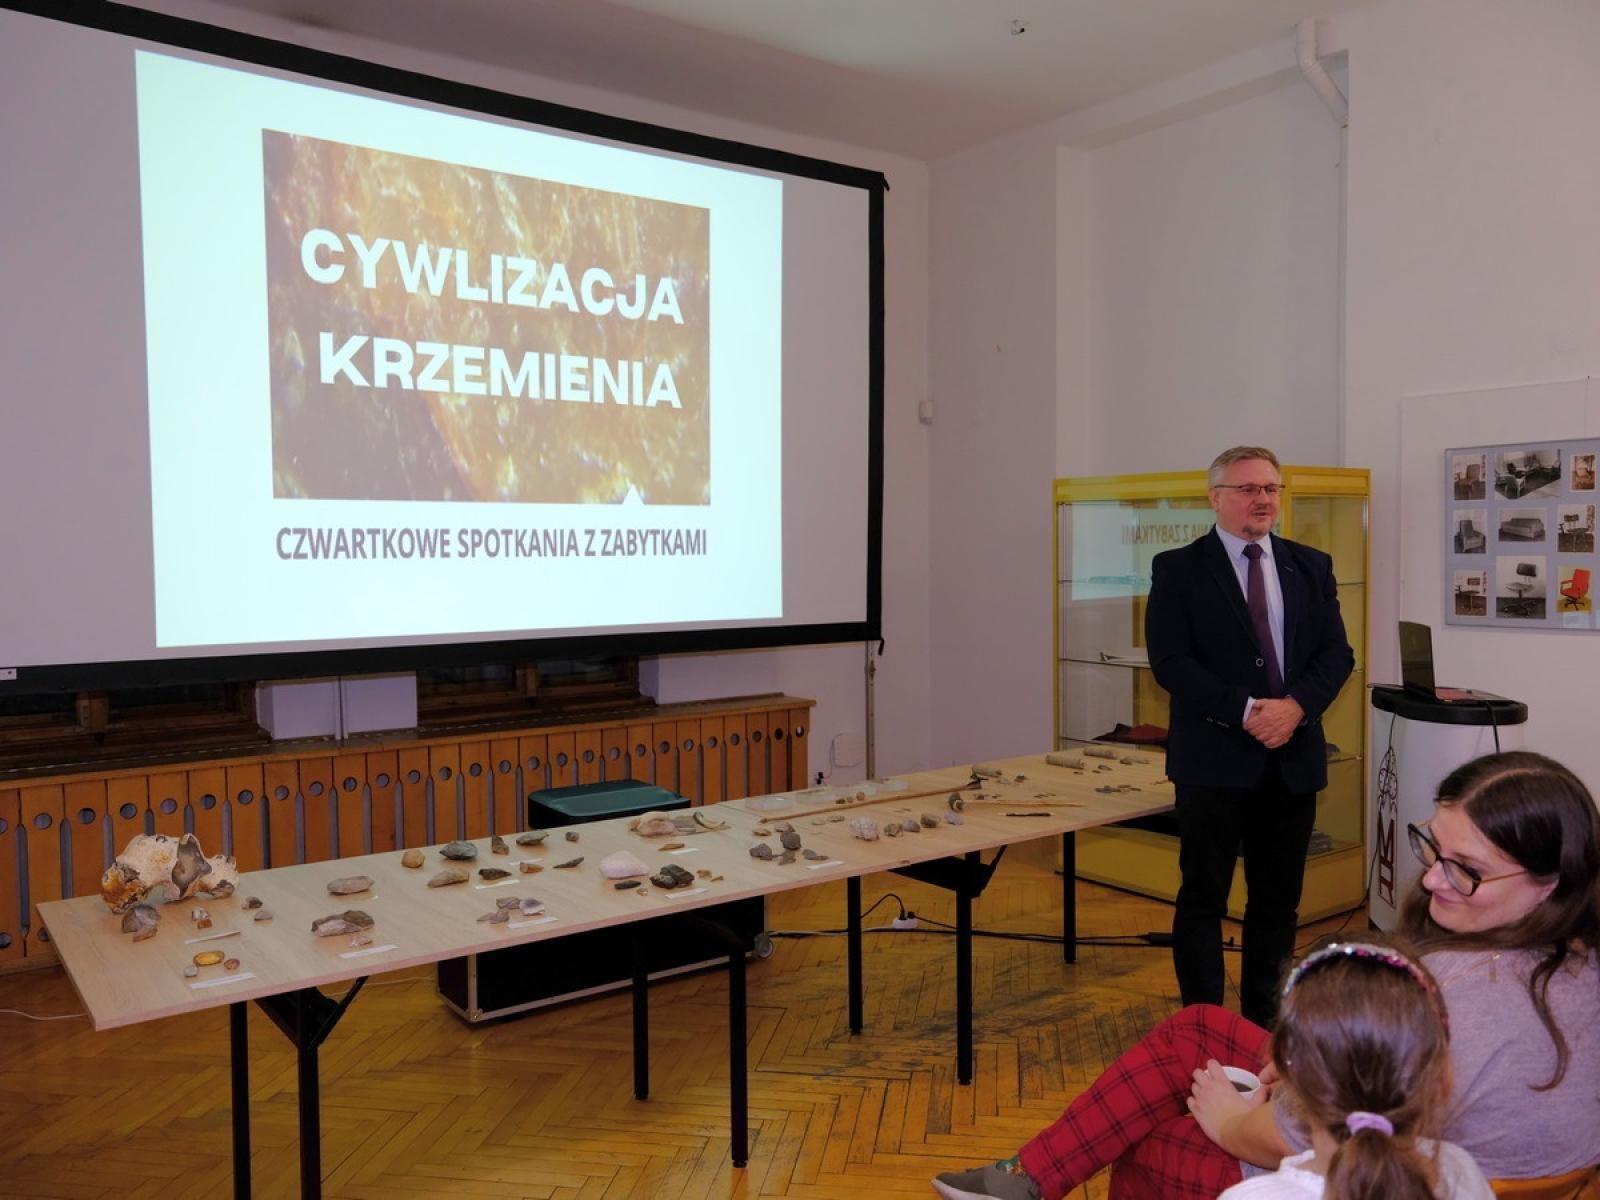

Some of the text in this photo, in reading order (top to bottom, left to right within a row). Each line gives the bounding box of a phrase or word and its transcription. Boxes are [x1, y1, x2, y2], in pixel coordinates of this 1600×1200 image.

[301, 228, 684, 325] CYWLIZACJA
[318, 331, 682, 409] KRZEMIENIA
[275, 526, 707, 561] CZWARTKOWE SPOTKANIA Z ZABYTKAMI
